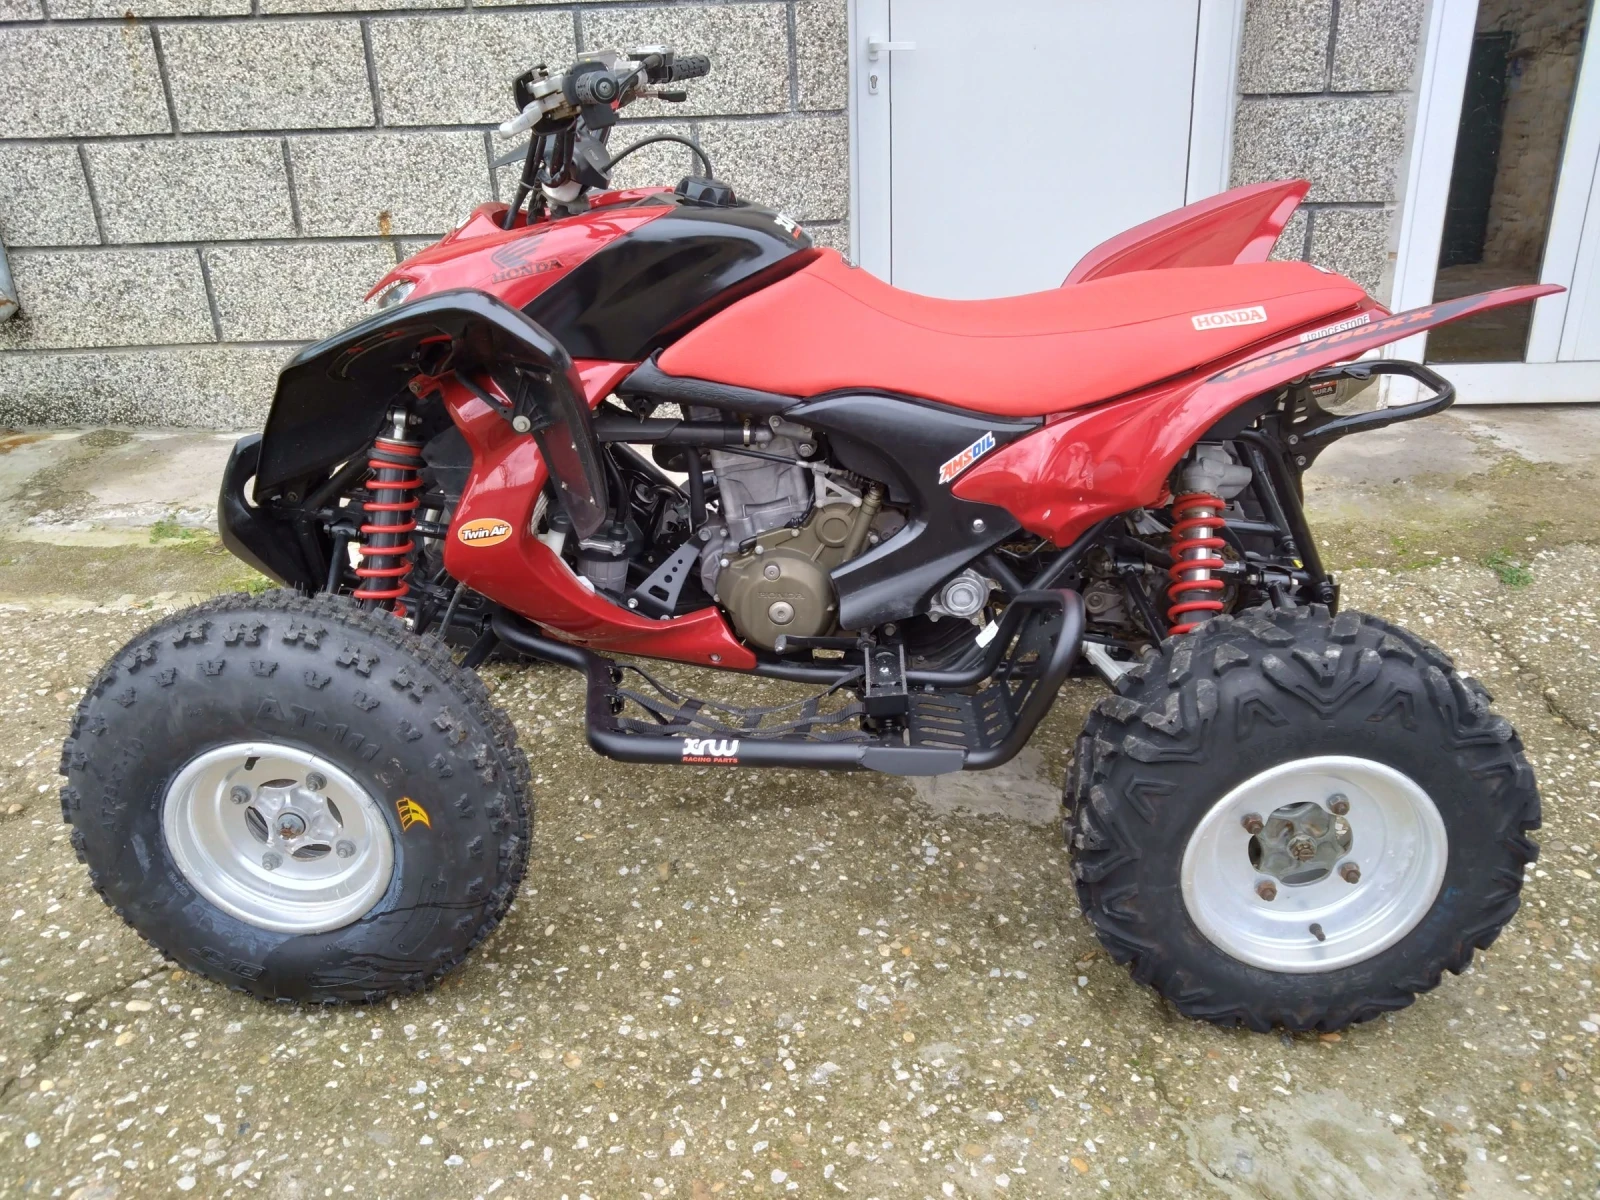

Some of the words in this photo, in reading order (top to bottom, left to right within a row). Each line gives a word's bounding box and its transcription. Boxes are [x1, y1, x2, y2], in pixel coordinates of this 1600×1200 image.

[492, 259, 564, 282] HONDA
[1195, 308, 1264, 328] HONDA
[941, 433, 994, 481] AMSOIL
[462, 527, 490, 541] Twin
[490, 524, 509, 537] Air
[256, 697, 383, 763] AT-111
